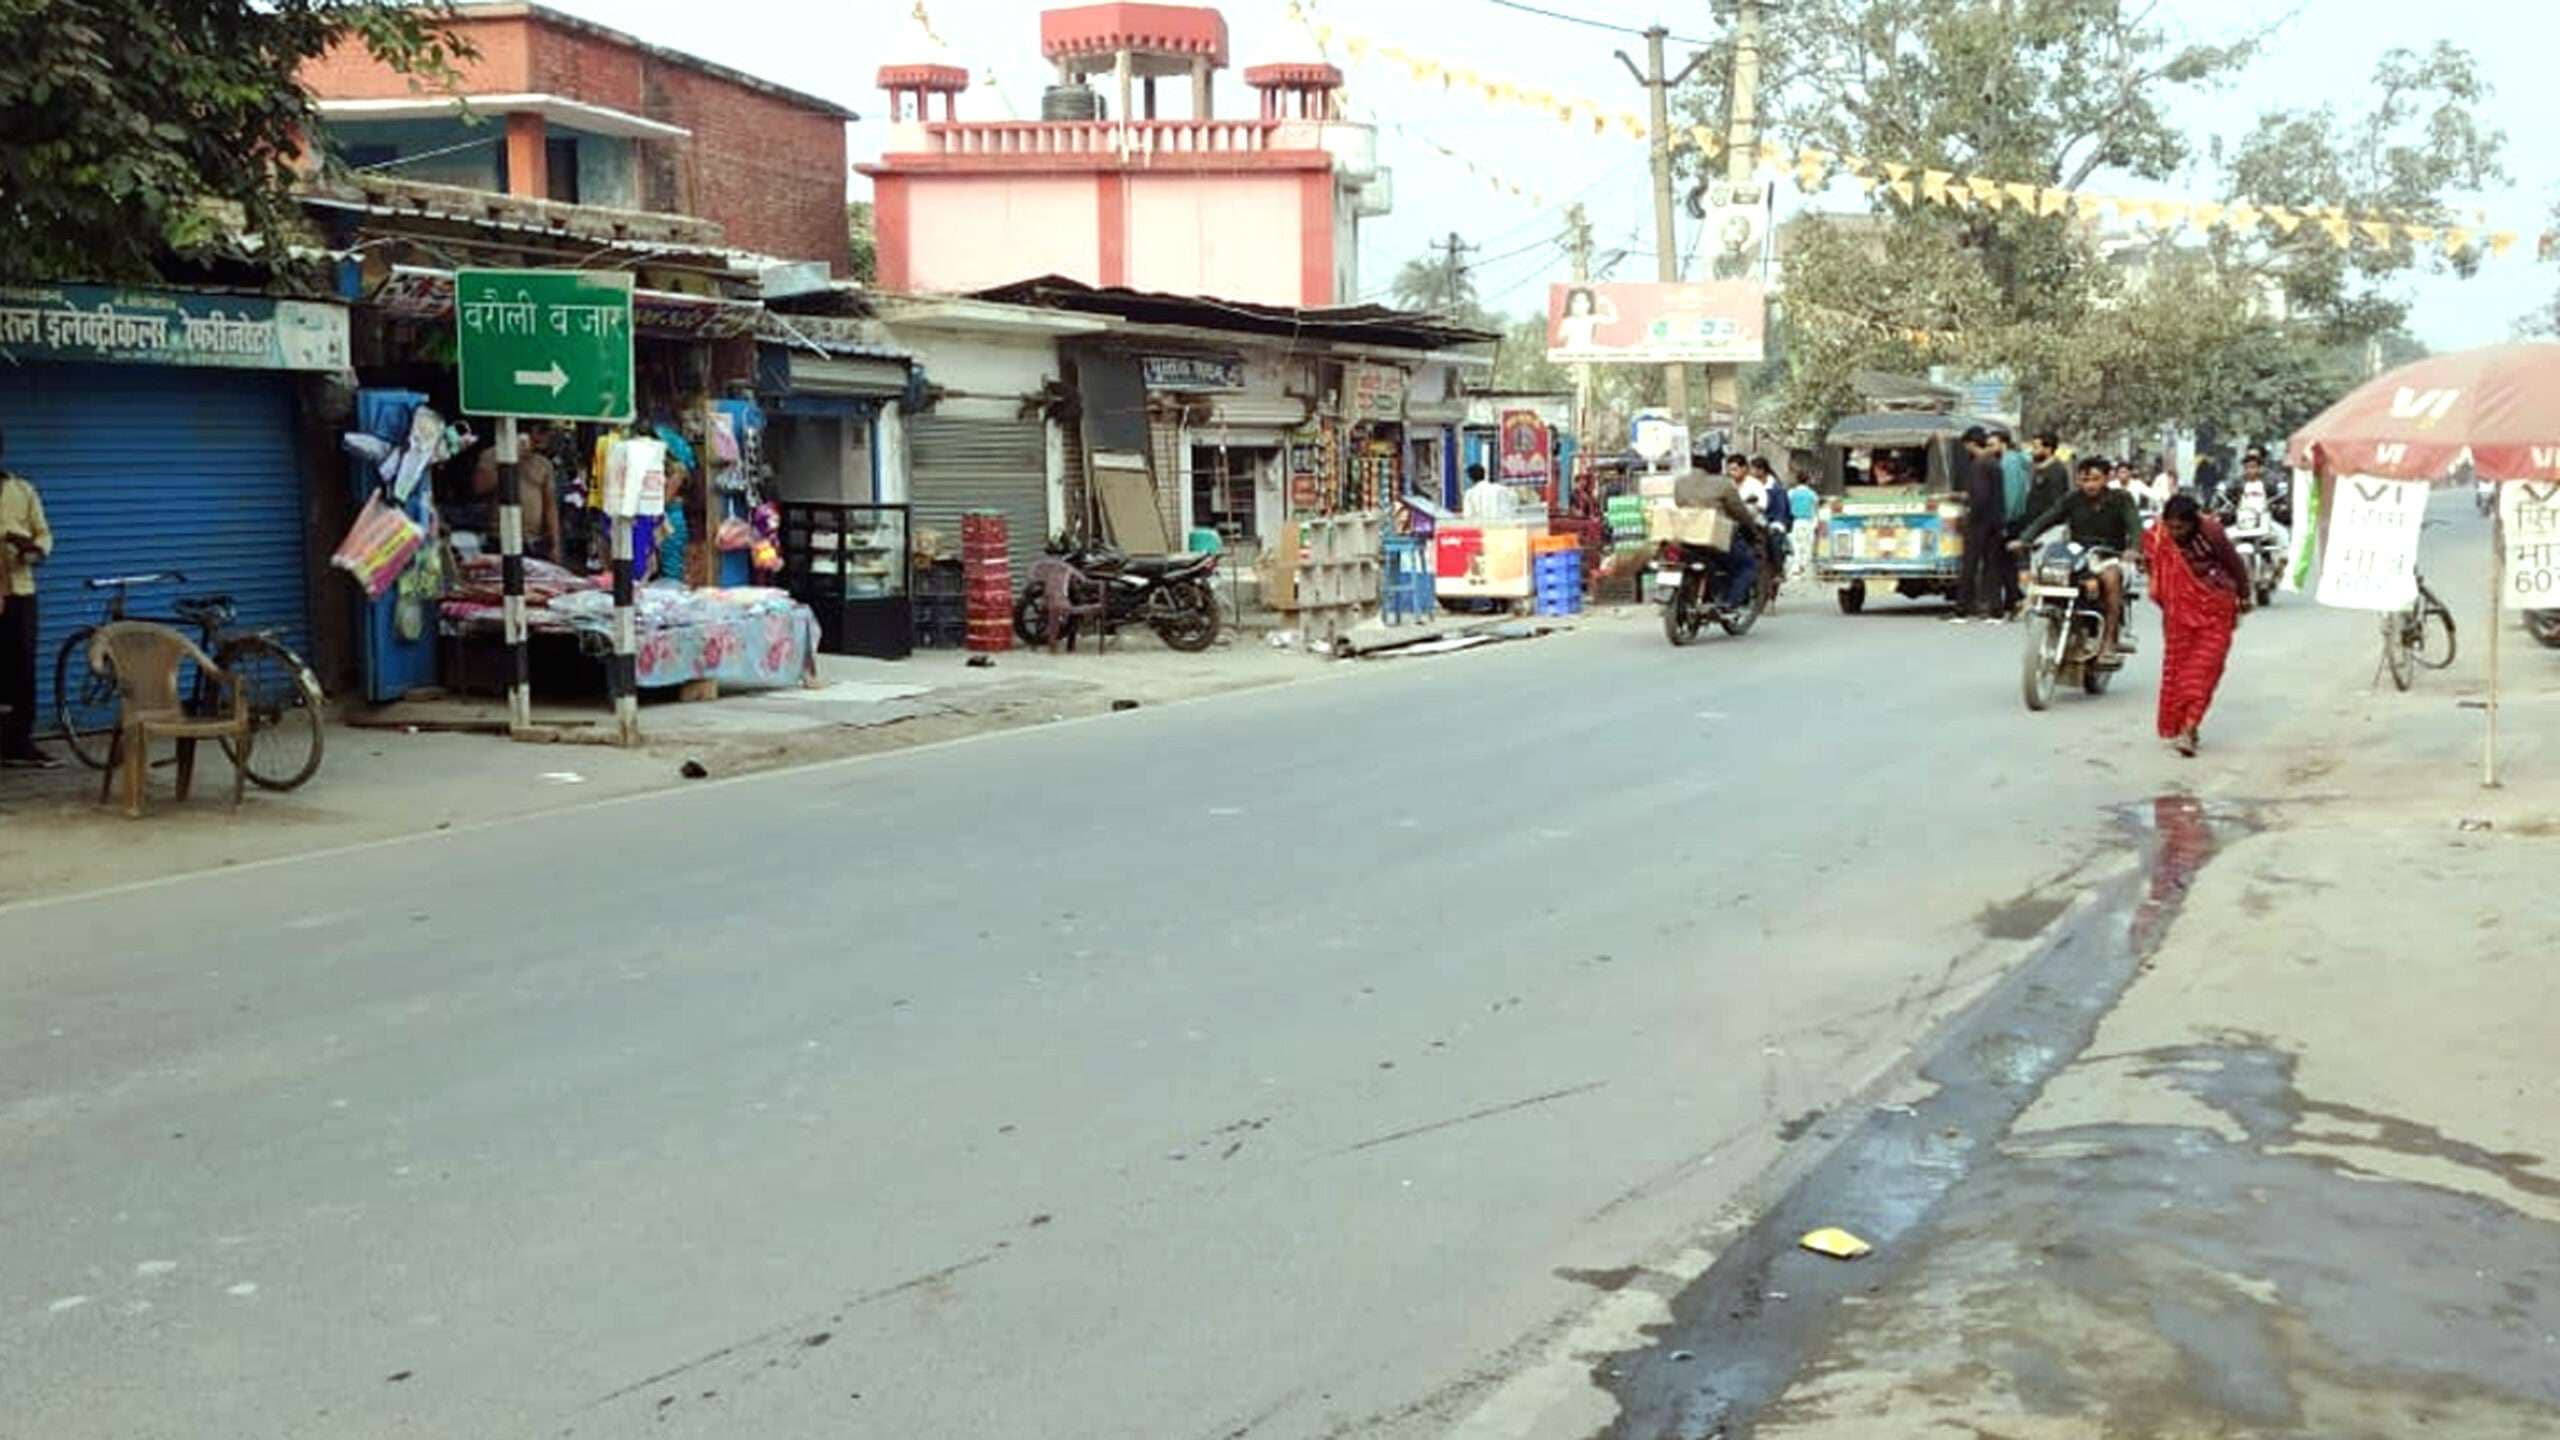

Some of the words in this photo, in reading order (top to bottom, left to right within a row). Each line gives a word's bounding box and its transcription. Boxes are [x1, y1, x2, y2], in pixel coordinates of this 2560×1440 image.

[2391, 385, 2460, 419] VI
[2376, 442, 2408, 465] VI
[2353, 481, 2403, 505] VI
[2515, 568, 2560, 593] 60
